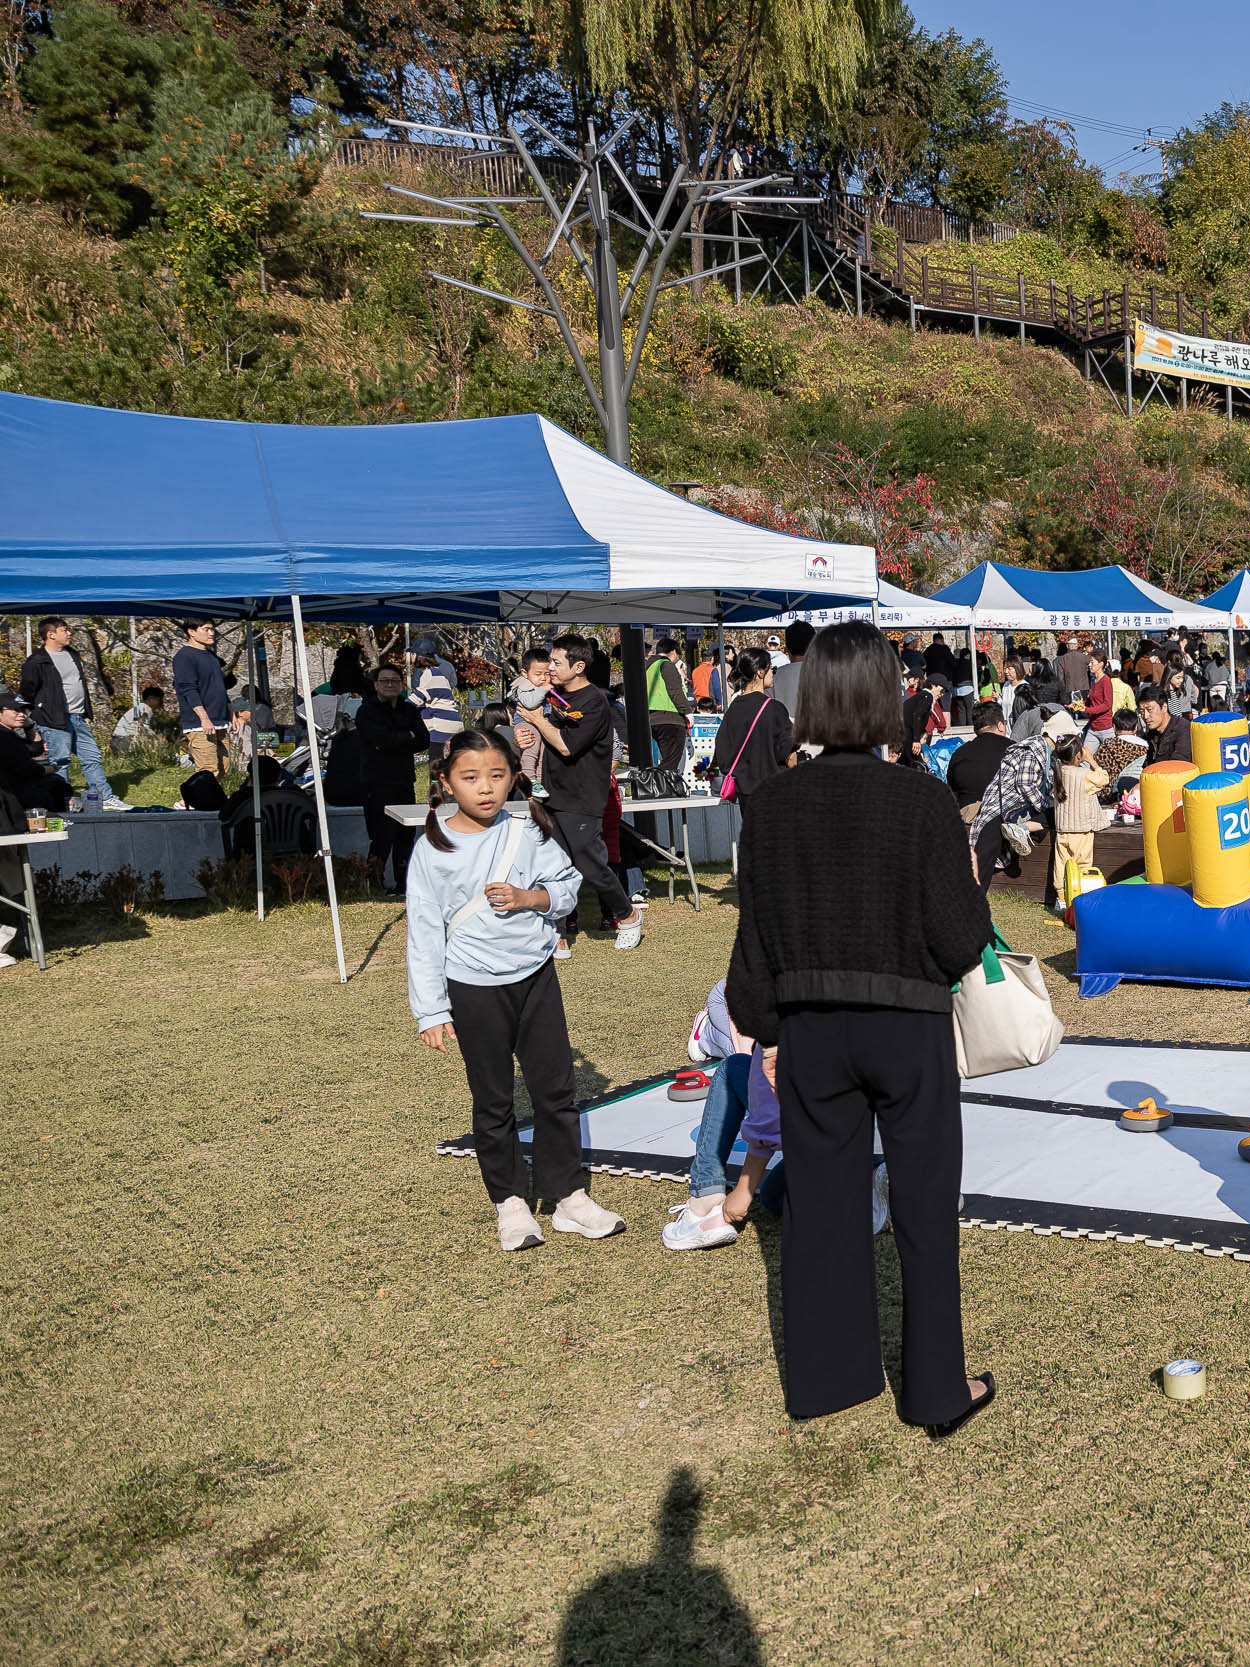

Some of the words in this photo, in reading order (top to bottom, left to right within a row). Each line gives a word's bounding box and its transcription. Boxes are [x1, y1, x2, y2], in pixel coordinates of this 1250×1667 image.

[1177, 345, 1222, 367] 광나루
[1049, 615, 1082, 627] 광장동
[1088, 615, 1153, 627] 자원봉사캠프
[1224, 744, 1250, 770] 50
[1222, 808, 1250, 841] 20
